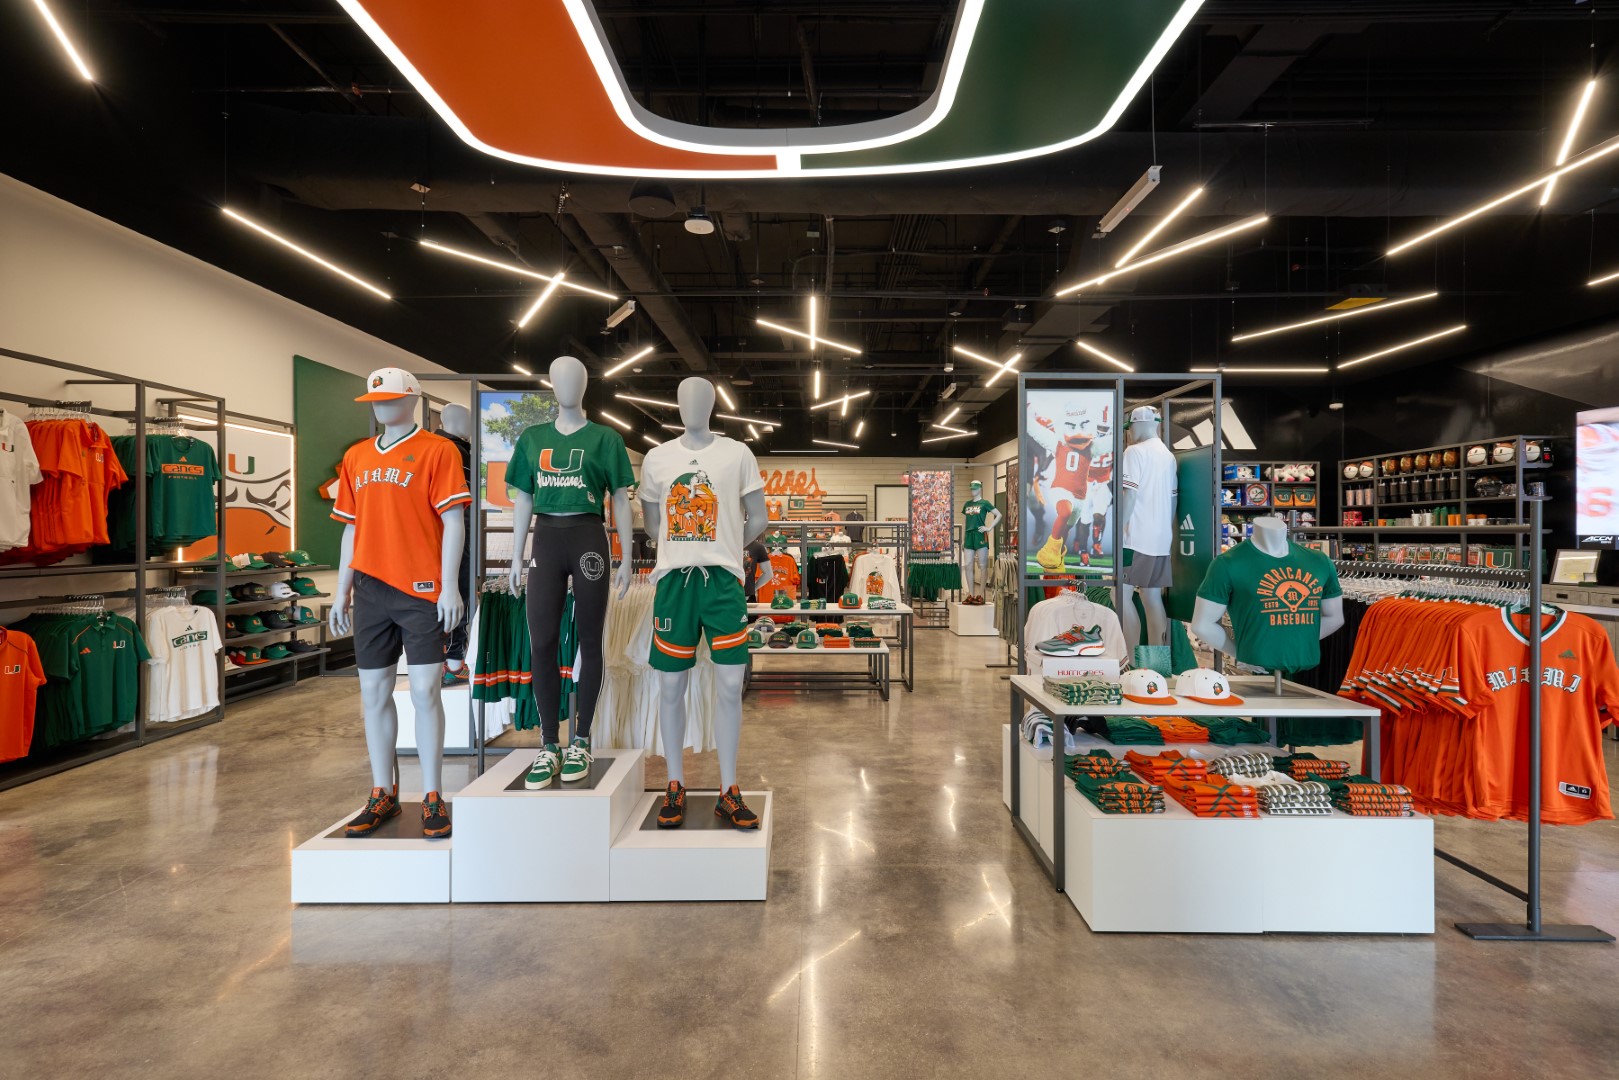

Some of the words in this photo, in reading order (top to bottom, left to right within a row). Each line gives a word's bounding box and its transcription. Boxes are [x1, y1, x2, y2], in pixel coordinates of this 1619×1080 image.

[228, 453, 255, 475] U
[539, 449, 584, 473] U
[1065, 452, 1080, 472] 0
[537, 472, 587, 488] Hurricanes
[1180, 541, 1195, 556] U
[1485, 551, 1513, 569] U
[1257, 567, 1323, 596] HURRICANES
[655, 617, 671, 631] U
[1270, 613, 1314, 625] BASEBALL
[113, 640, 126, 649] U
[4, 665, 21, 674] U
